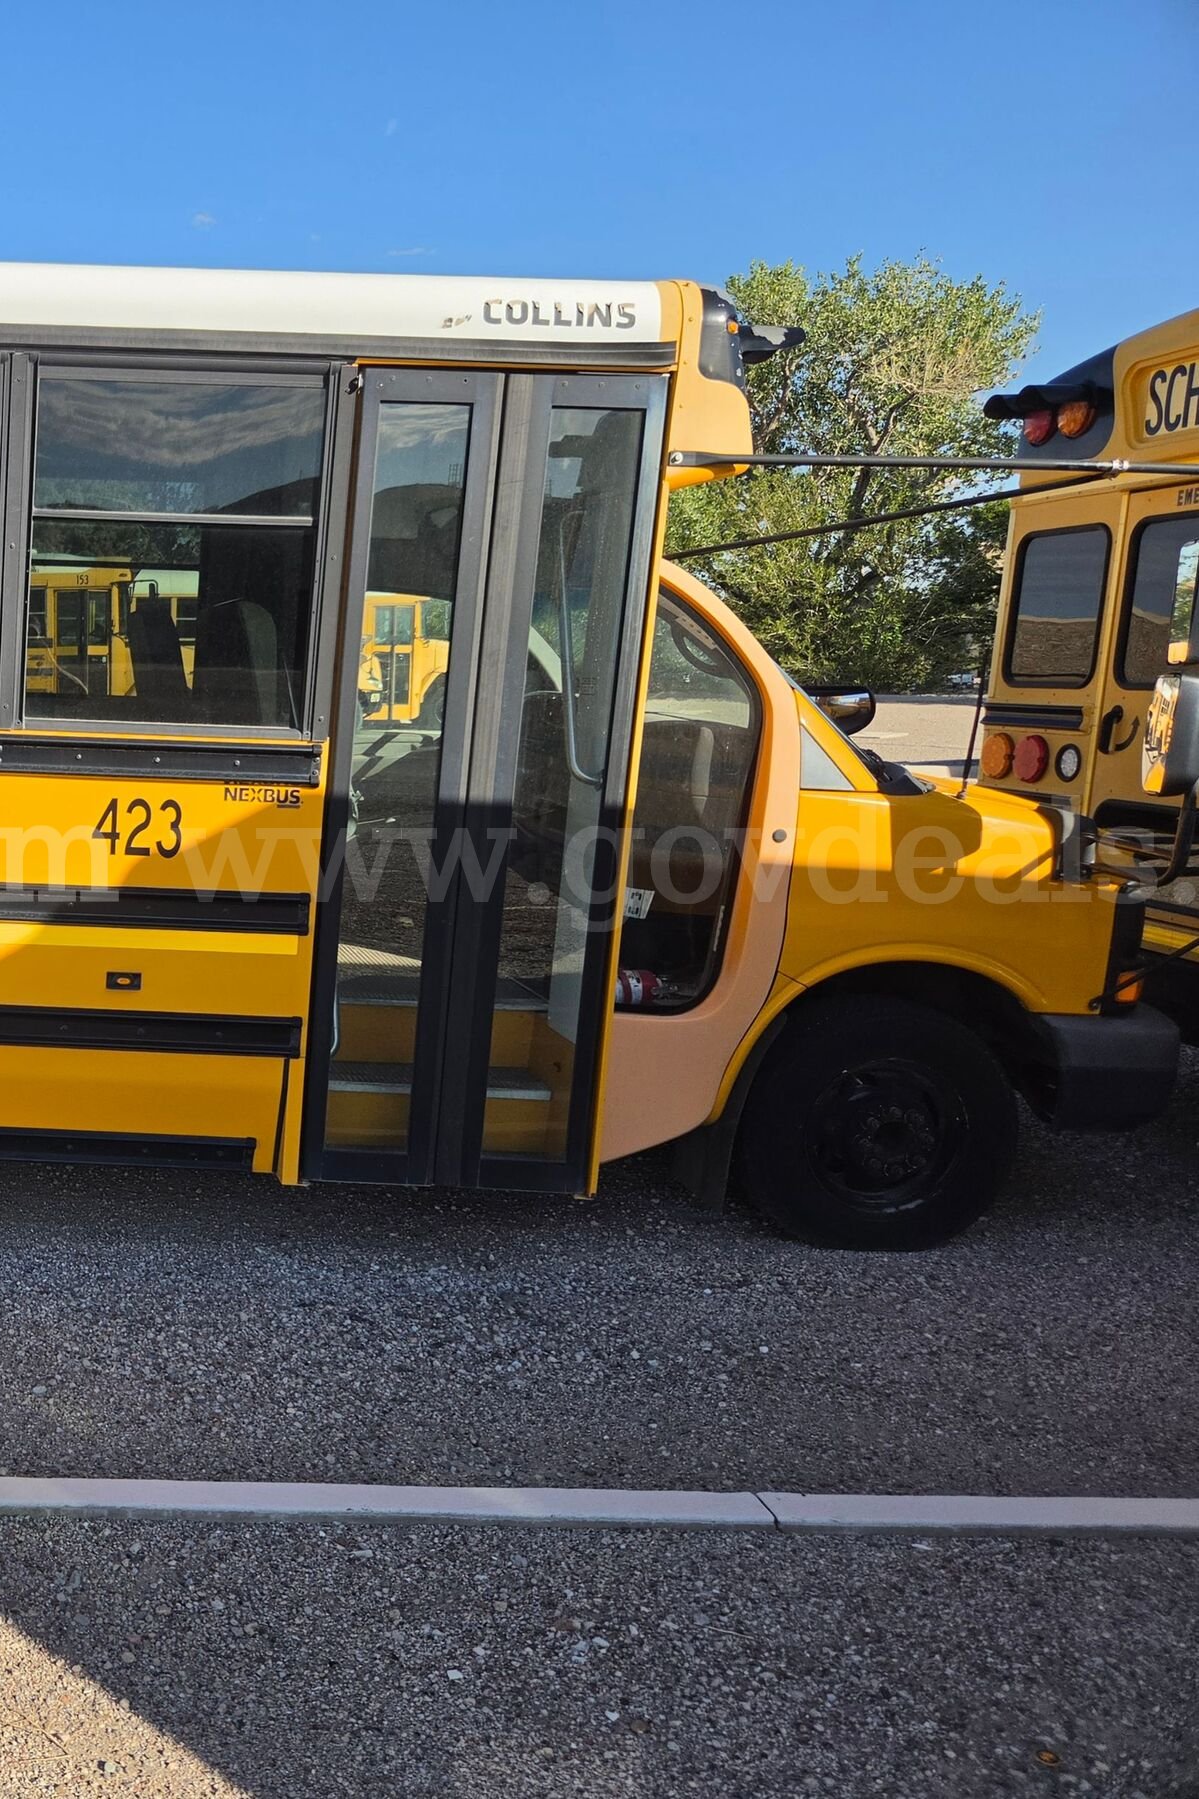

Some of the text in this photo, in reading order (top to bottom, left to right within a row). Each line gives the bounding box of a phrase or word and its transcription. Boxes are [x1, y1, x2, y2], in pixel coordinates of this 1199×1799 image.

[483, 298, 637, 330] COLLINS
[76, 575, 89, 585] 153
[91, 797, 184, 858] 423
